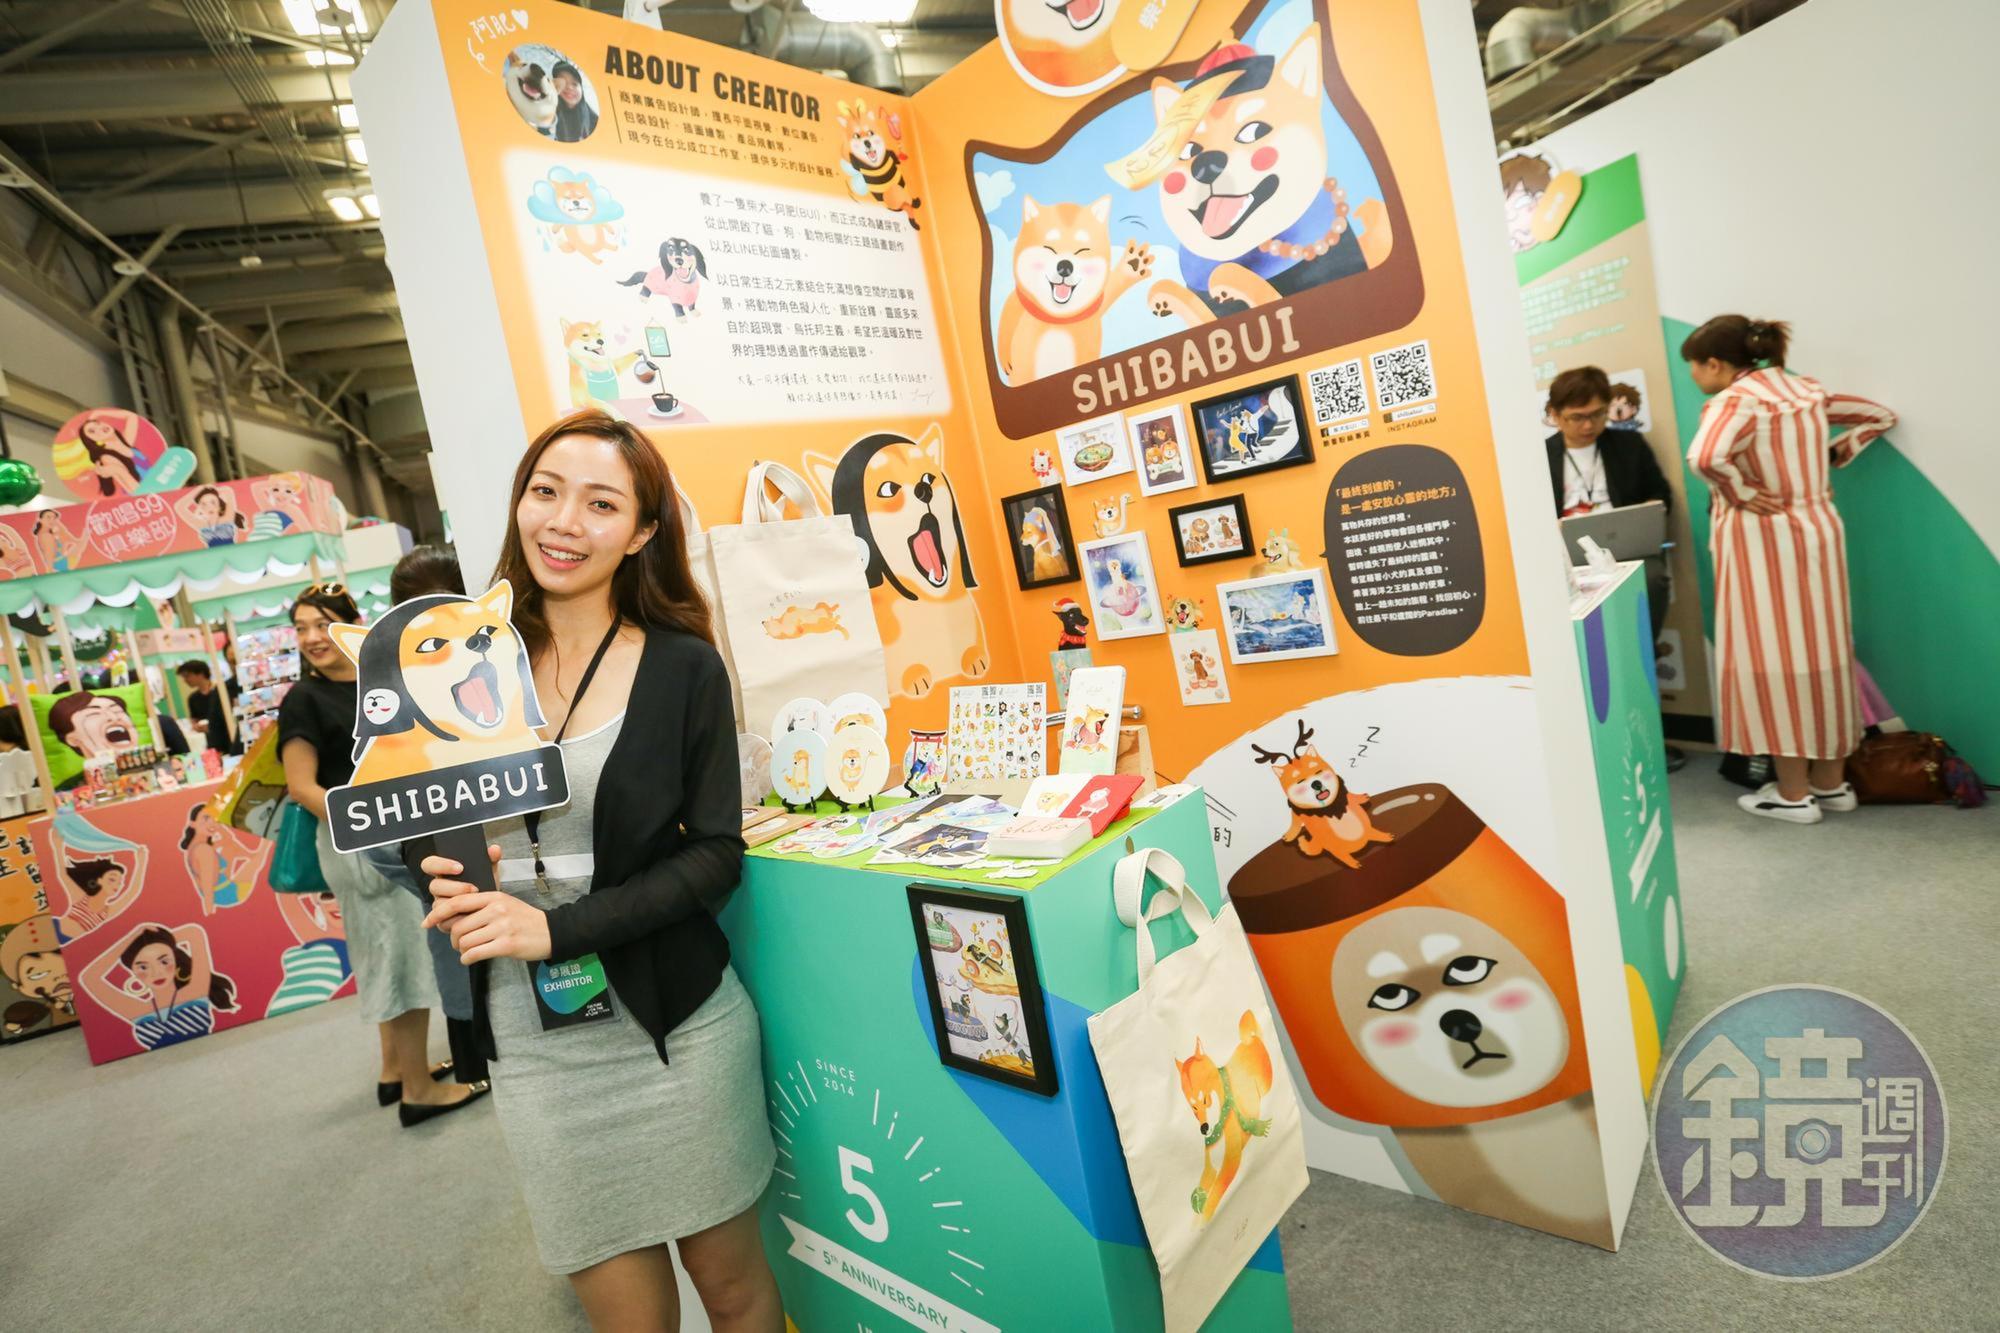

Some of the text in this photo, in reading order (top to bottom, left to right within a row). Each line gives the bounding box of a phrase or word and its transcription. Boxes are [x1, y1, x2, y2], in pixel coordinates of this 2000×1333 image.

[604, 45, 821, 122] ABOUT CREATOR
[1073, 307, 1300, 414] SHIBABUI
[1387, 416, 1437, 433] INSTAGRAM
[103, 515, 174, 556] 俱樂部
[346, 762, 550, 832] SHIBABUI
[543, 973, 593, 993] EXHIBITOR
[815, 1058, 857, 1082] SINCE
[823, 1077, 855, 1097] 2014
[837, 1144, 889, 1244] 5
[841, 1255, 949, 1330] ANNIVERSARY
